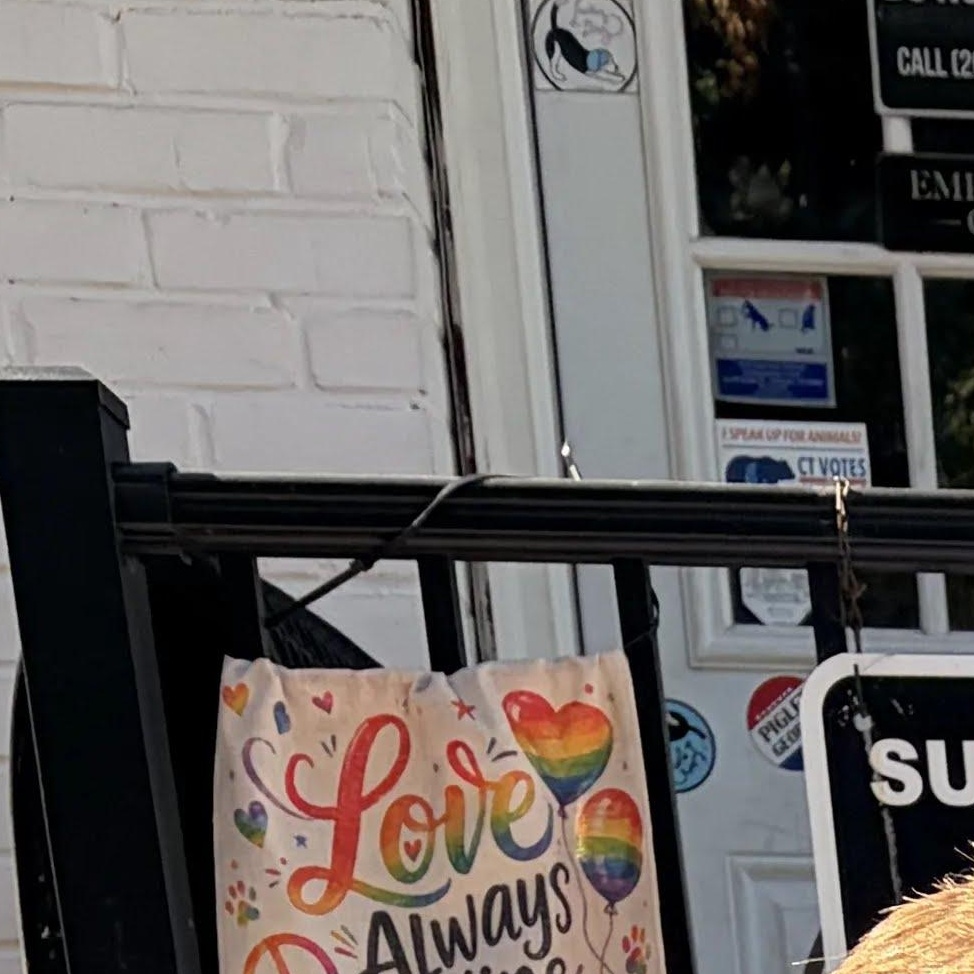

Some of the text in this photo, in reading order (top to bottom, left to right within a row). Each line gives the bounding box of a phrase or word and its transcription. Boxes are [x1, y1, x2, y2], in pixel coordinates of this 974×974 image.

[896, 46, 949, 78] CALL
[765, 428, 782, 441] UP
[797, 456, 867, 478] CT VOTES
[243, 713, 554, 916] Love
